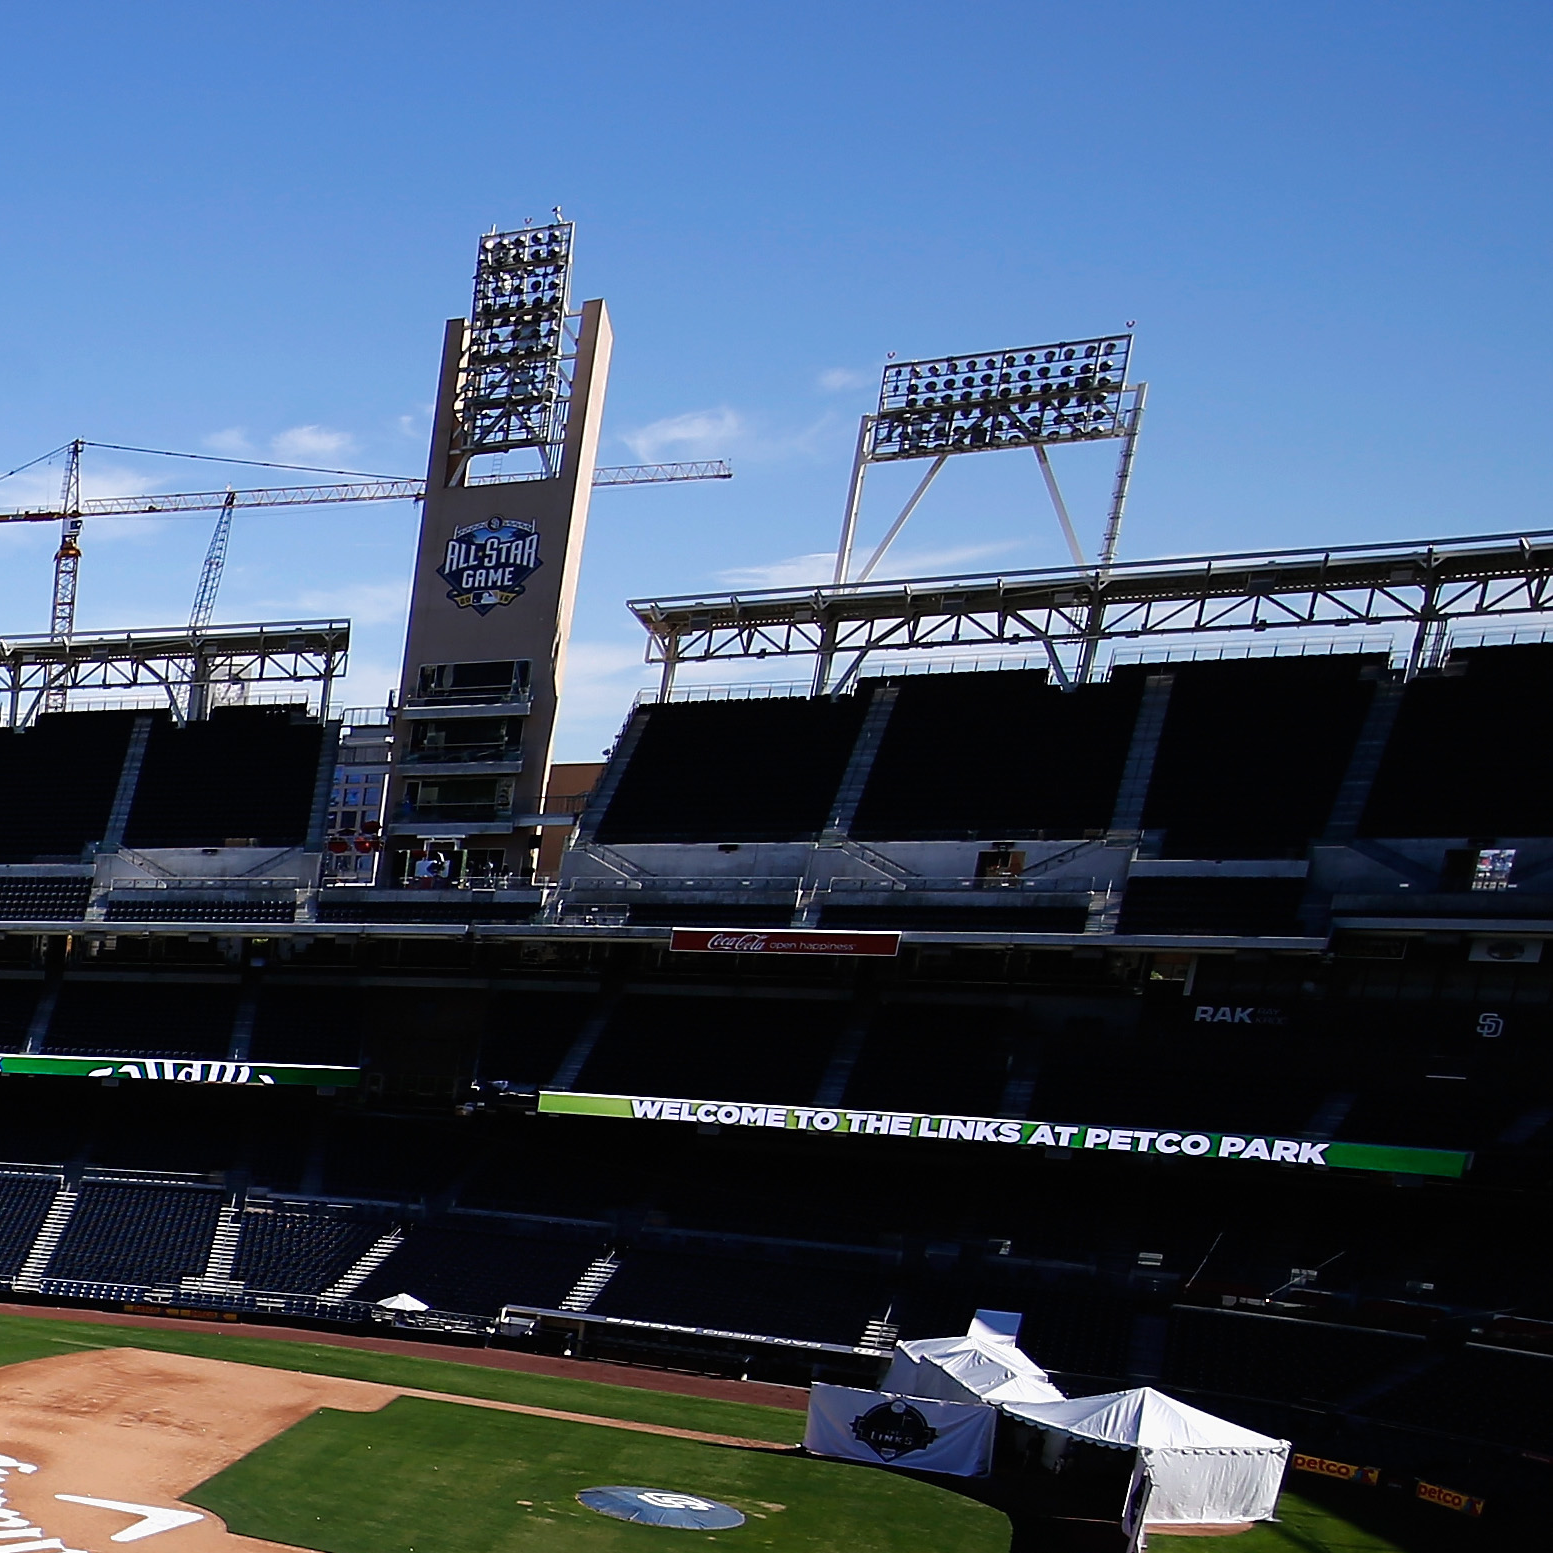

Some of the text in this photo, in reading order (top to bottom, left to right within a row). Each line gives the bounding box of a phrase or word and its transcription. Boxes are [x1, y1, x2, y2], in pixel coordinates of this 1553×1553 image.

[462, 567, 514, 588] GAME
[707, 933, 853, 951] Coca-Cola open happiness
[1194, 1006, 1254, 1024] RAK
[632, 1100, 1329, 1166] WELCOME TO THE LINKS AT PETCO PARK
[870, 1430, 913, 1446] LINKS
[1294, 1456, 1350, 1477] petco
[1418, 1483, 1462, 1507] petco
